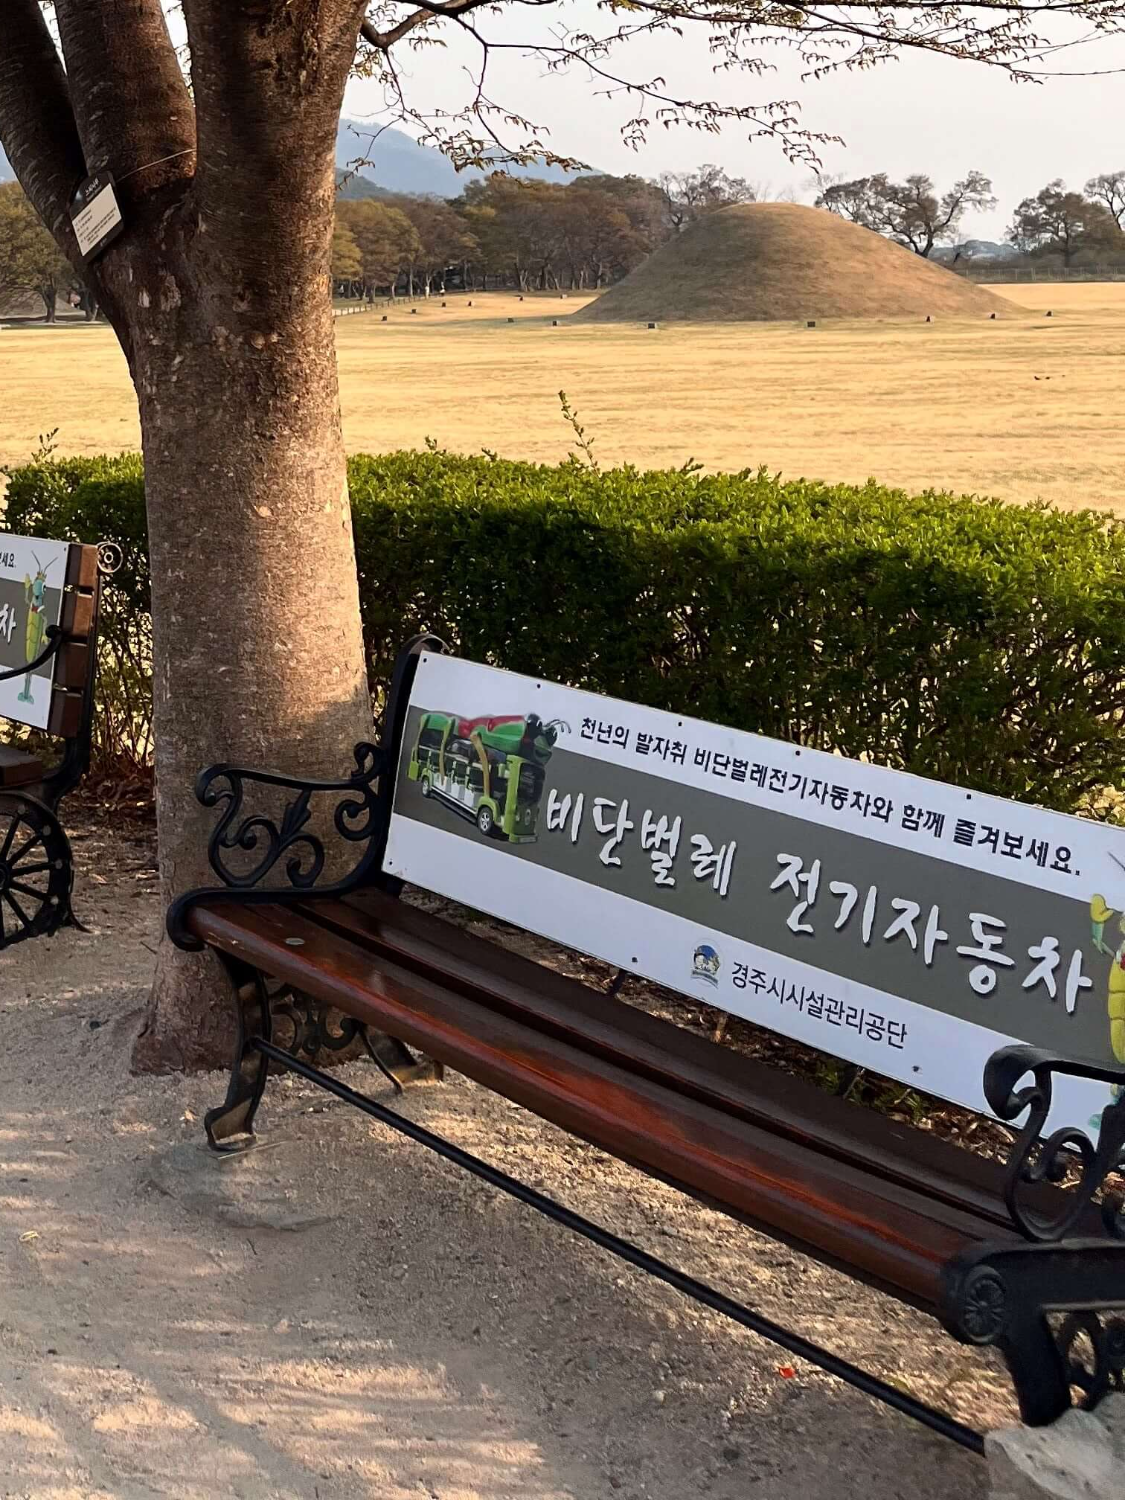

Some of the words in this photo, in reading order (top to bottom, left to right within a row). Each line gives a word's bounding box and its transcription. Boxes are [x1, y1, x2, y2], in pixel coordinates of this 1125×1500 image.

[580, 717, 629, 749] 천년의
[635, 732, 687, 766] 발자취
[693, 748, 893, 824] 비단벌레전기자동차와
[901, 804, 945, 838] 함께
[953, 818, 1080, 876] 즐겨보세요.
[546, 788, 737, 898] 비단벌레
[769, 852, 1094, 1015] 전기자동차
[731, 961, 907, 1050] 경주시시설관리공단
